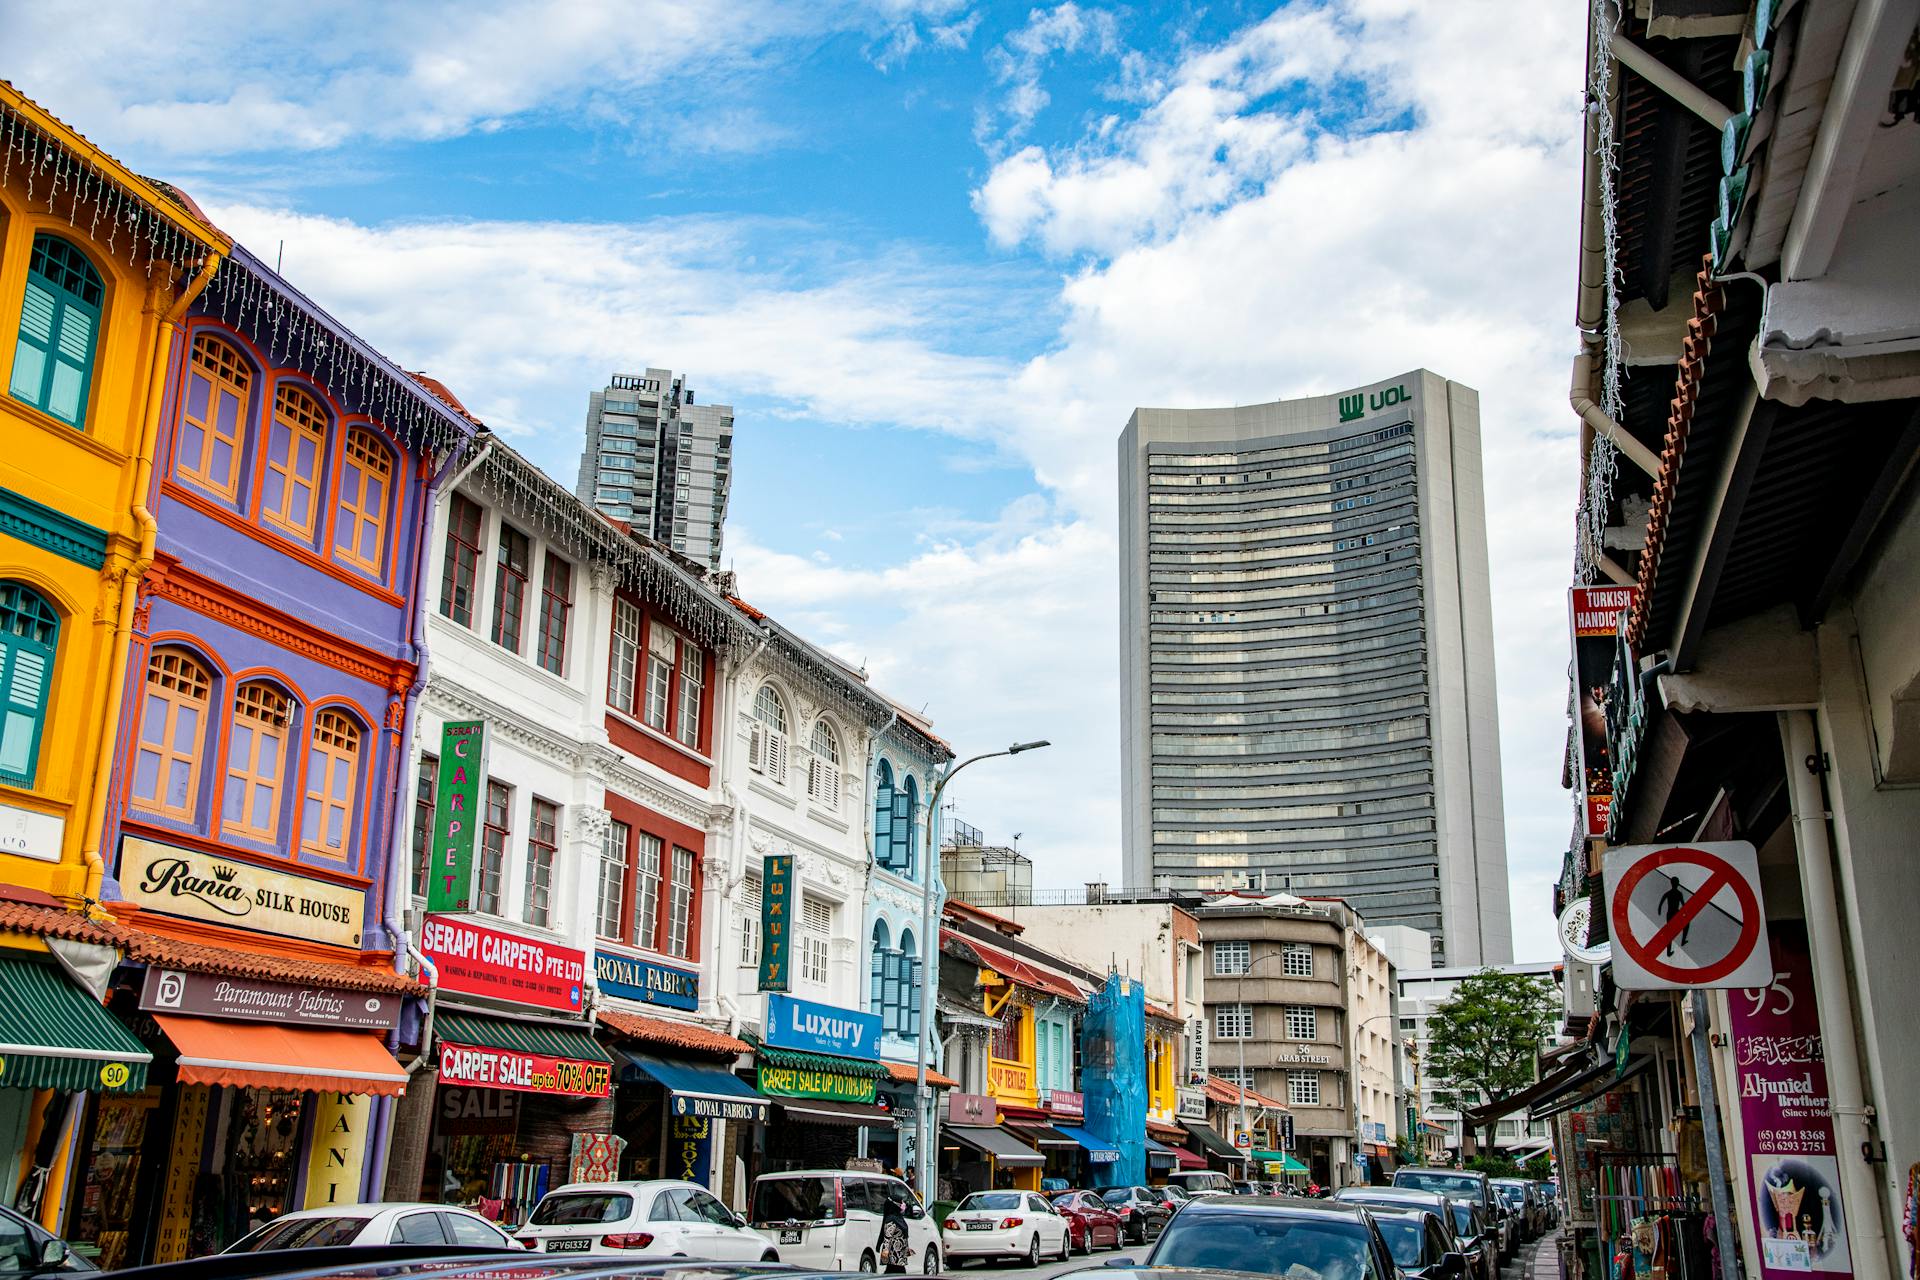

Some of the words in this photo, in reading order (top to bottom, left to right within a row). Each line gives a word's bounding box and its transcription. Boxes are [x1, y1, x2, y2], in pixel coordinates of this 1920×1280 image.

[1370, 384, 1412, 411] UOL
[1586, 590, 1631, 608] TURKISH
[442, 739, 469, 894] CARPET
[140, 858, 249, 913] Rania
[255, 888, 295, 914] SILK
[299, 897, 350, 924] HOUSE
[768, 859, 784, 980] Luxury
[423, 921, 479, 960] SERAPI
[481, 934, 544, 975] CARPETS
[545, 956, 564, 978] PTE
[565, 959, 583, 982] LTD
[597, 956, 643, 987] ROYAL
[646, 967, 699, 998] FABRICS
[213, 981, 294, 1009] Paramount
[295, 989, 344, 1014] Fabrics
[1744, 972, 1794, 1017] 95
[792, 1003, 864, 1048] Luxury
[1278, 1054, 1300, 1063] ARAB
[1300, 1054, 1330, 1064] STREET
[1298, 1044, 1310, 1054] 56
[107, 1067, 124, 1083] 90
[442, 1048, 499, 1082] CARPET
[498, 1055, 533, 1086] SALE
[532, 1072, 545, 1091] up
[544, 1071, 555, 1088] to
[555, 1061, 583, 1092] 70%
[583, 1064, 609, 1094] OFF
[761, 1066, 797, 1090] CARPET
[799, 1070, 820, 1093] SALE
[822, 1074, 832, 1093] UP
[833, 1075, 844, 1094] TO
[844, 1076, 859, 1097] 70%
[859, 1077, 873, 1097] OFF
[1742, 1072, 1815, 1102] Aljunied
[443, 1088, 514, 1119] SALE
[694, 1100, 721, 1117] ROYAL
[722, 1102, 753, 1119] FABRICS
[1782, 1108, 1808, 1118] (Since
[1758, 1130, 1774, 1141] (65)
[1775, 1130, 1797, 1140] 6291
[1800, 1130, 1826, 1140] 8368
[1759, 1141, 1775, 1152] (65)
[1777, 1141, 1799, 1151] 6293
[1801, 1141, 1826, 1152] 2751
[548, 1240, 590, 1250] SFV6133Z
